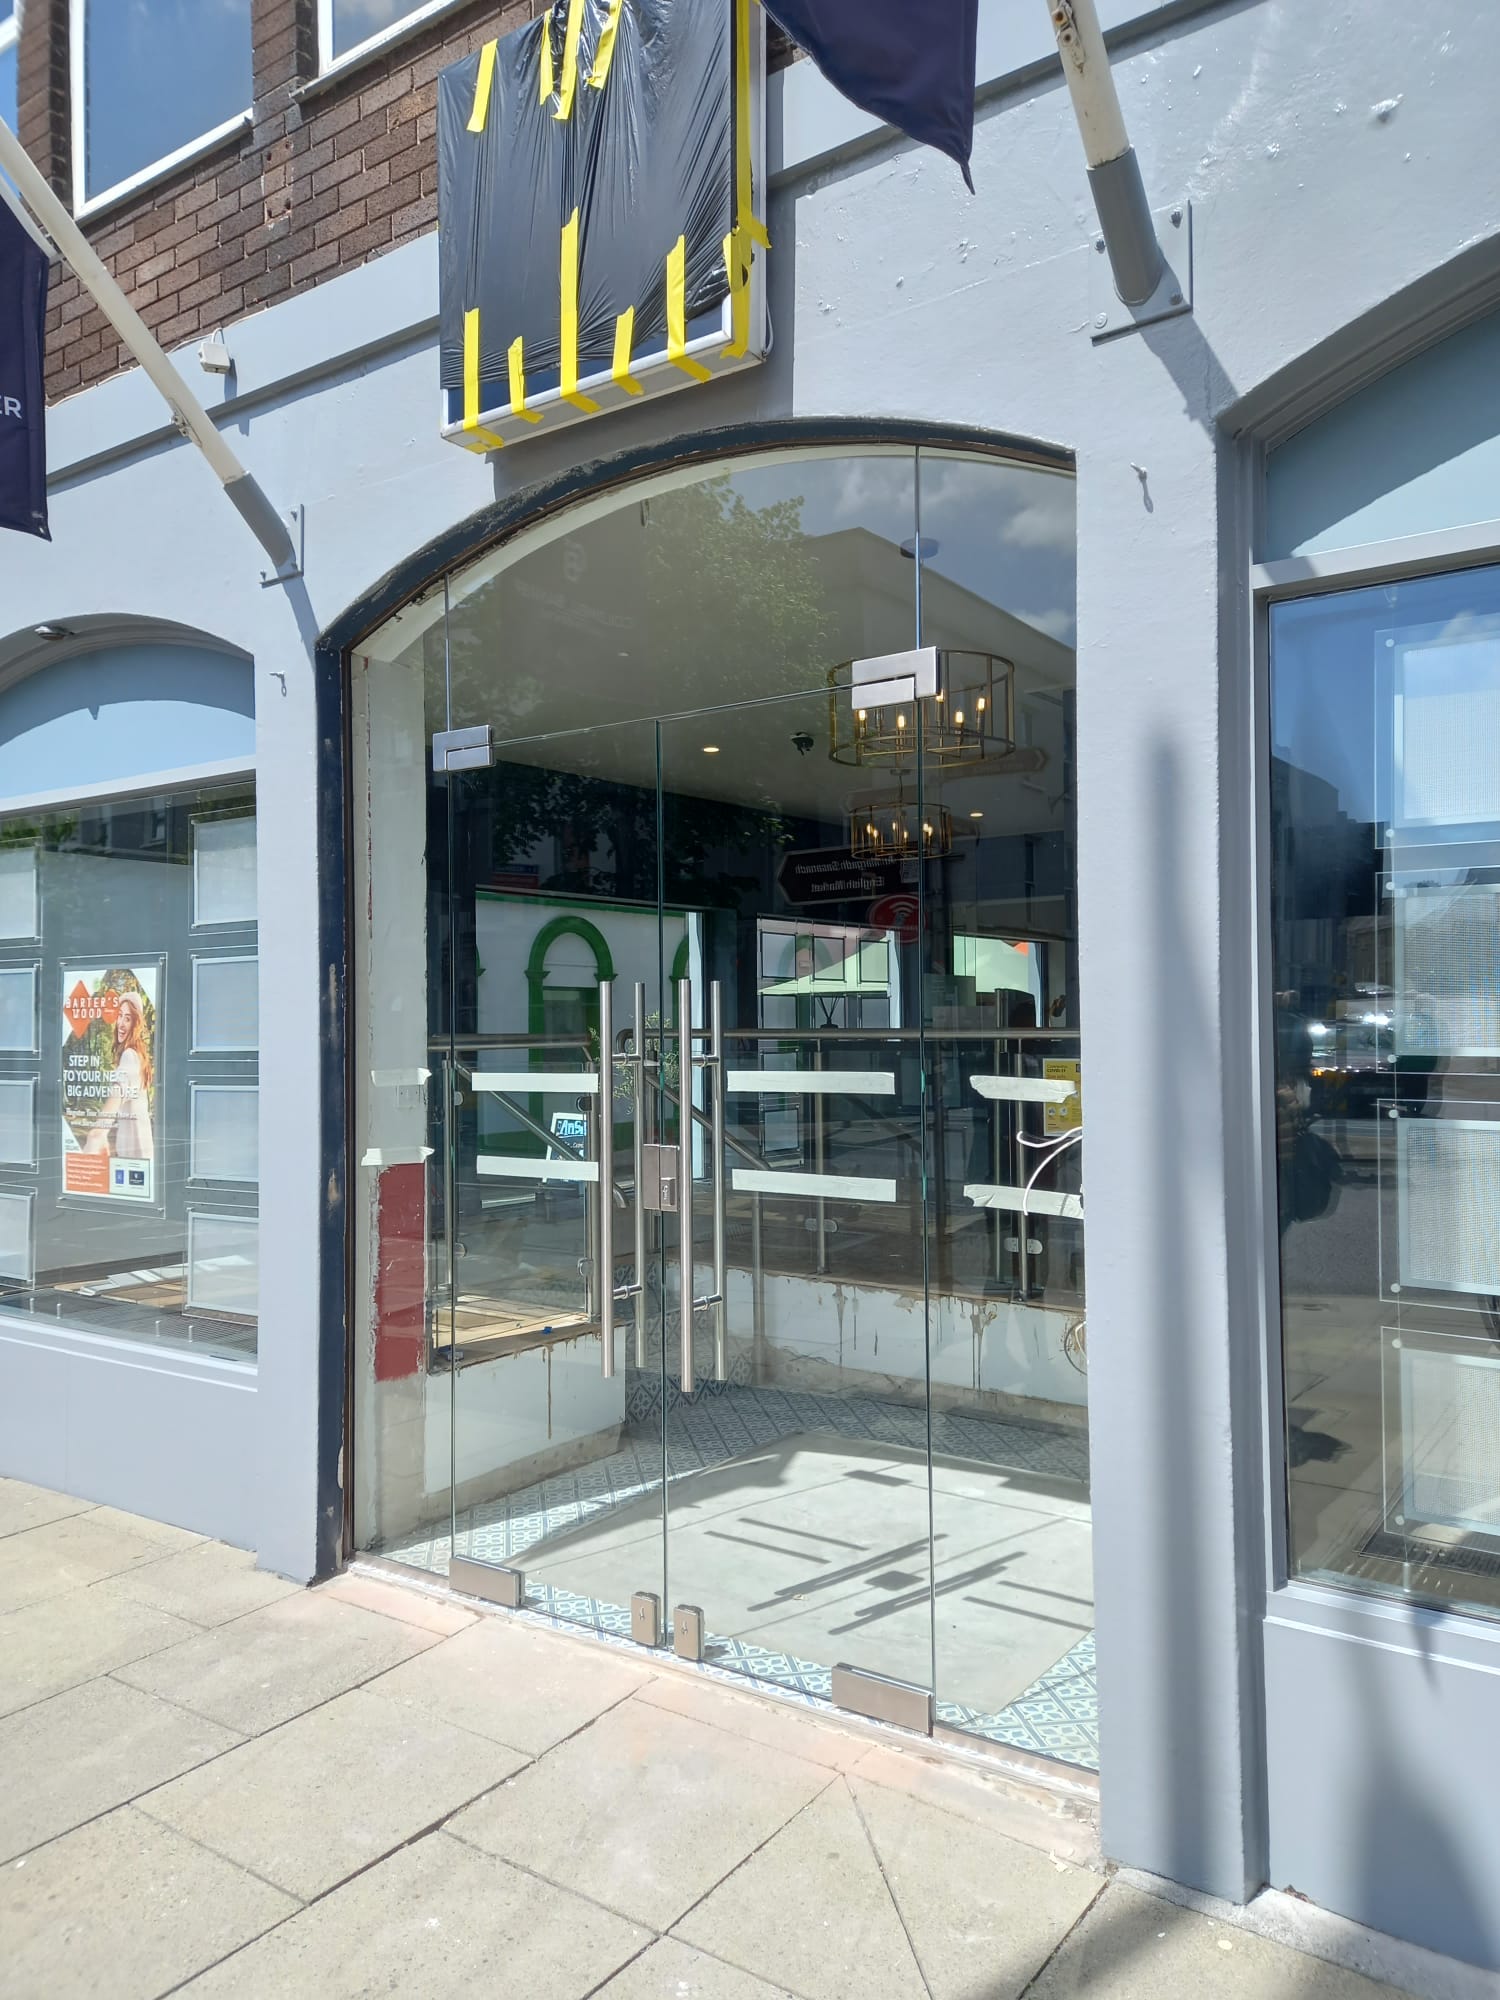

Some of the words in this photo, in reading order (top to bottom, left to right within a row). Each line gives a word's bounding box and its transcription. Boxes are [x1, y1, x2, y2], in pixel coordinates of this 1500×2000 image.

[72, 1009, 102, 1019] WOOD
[69, 1055, 88, 1067] STEP
[90, 1056, 100, 1067] IN
[63, 1070, 75, 1082] TO
[75, 1070, 101, 1082] YOUR
[67, 1085, 82, 1096] BIG
[83, 1086, 138, 1098] ADVENTURE
